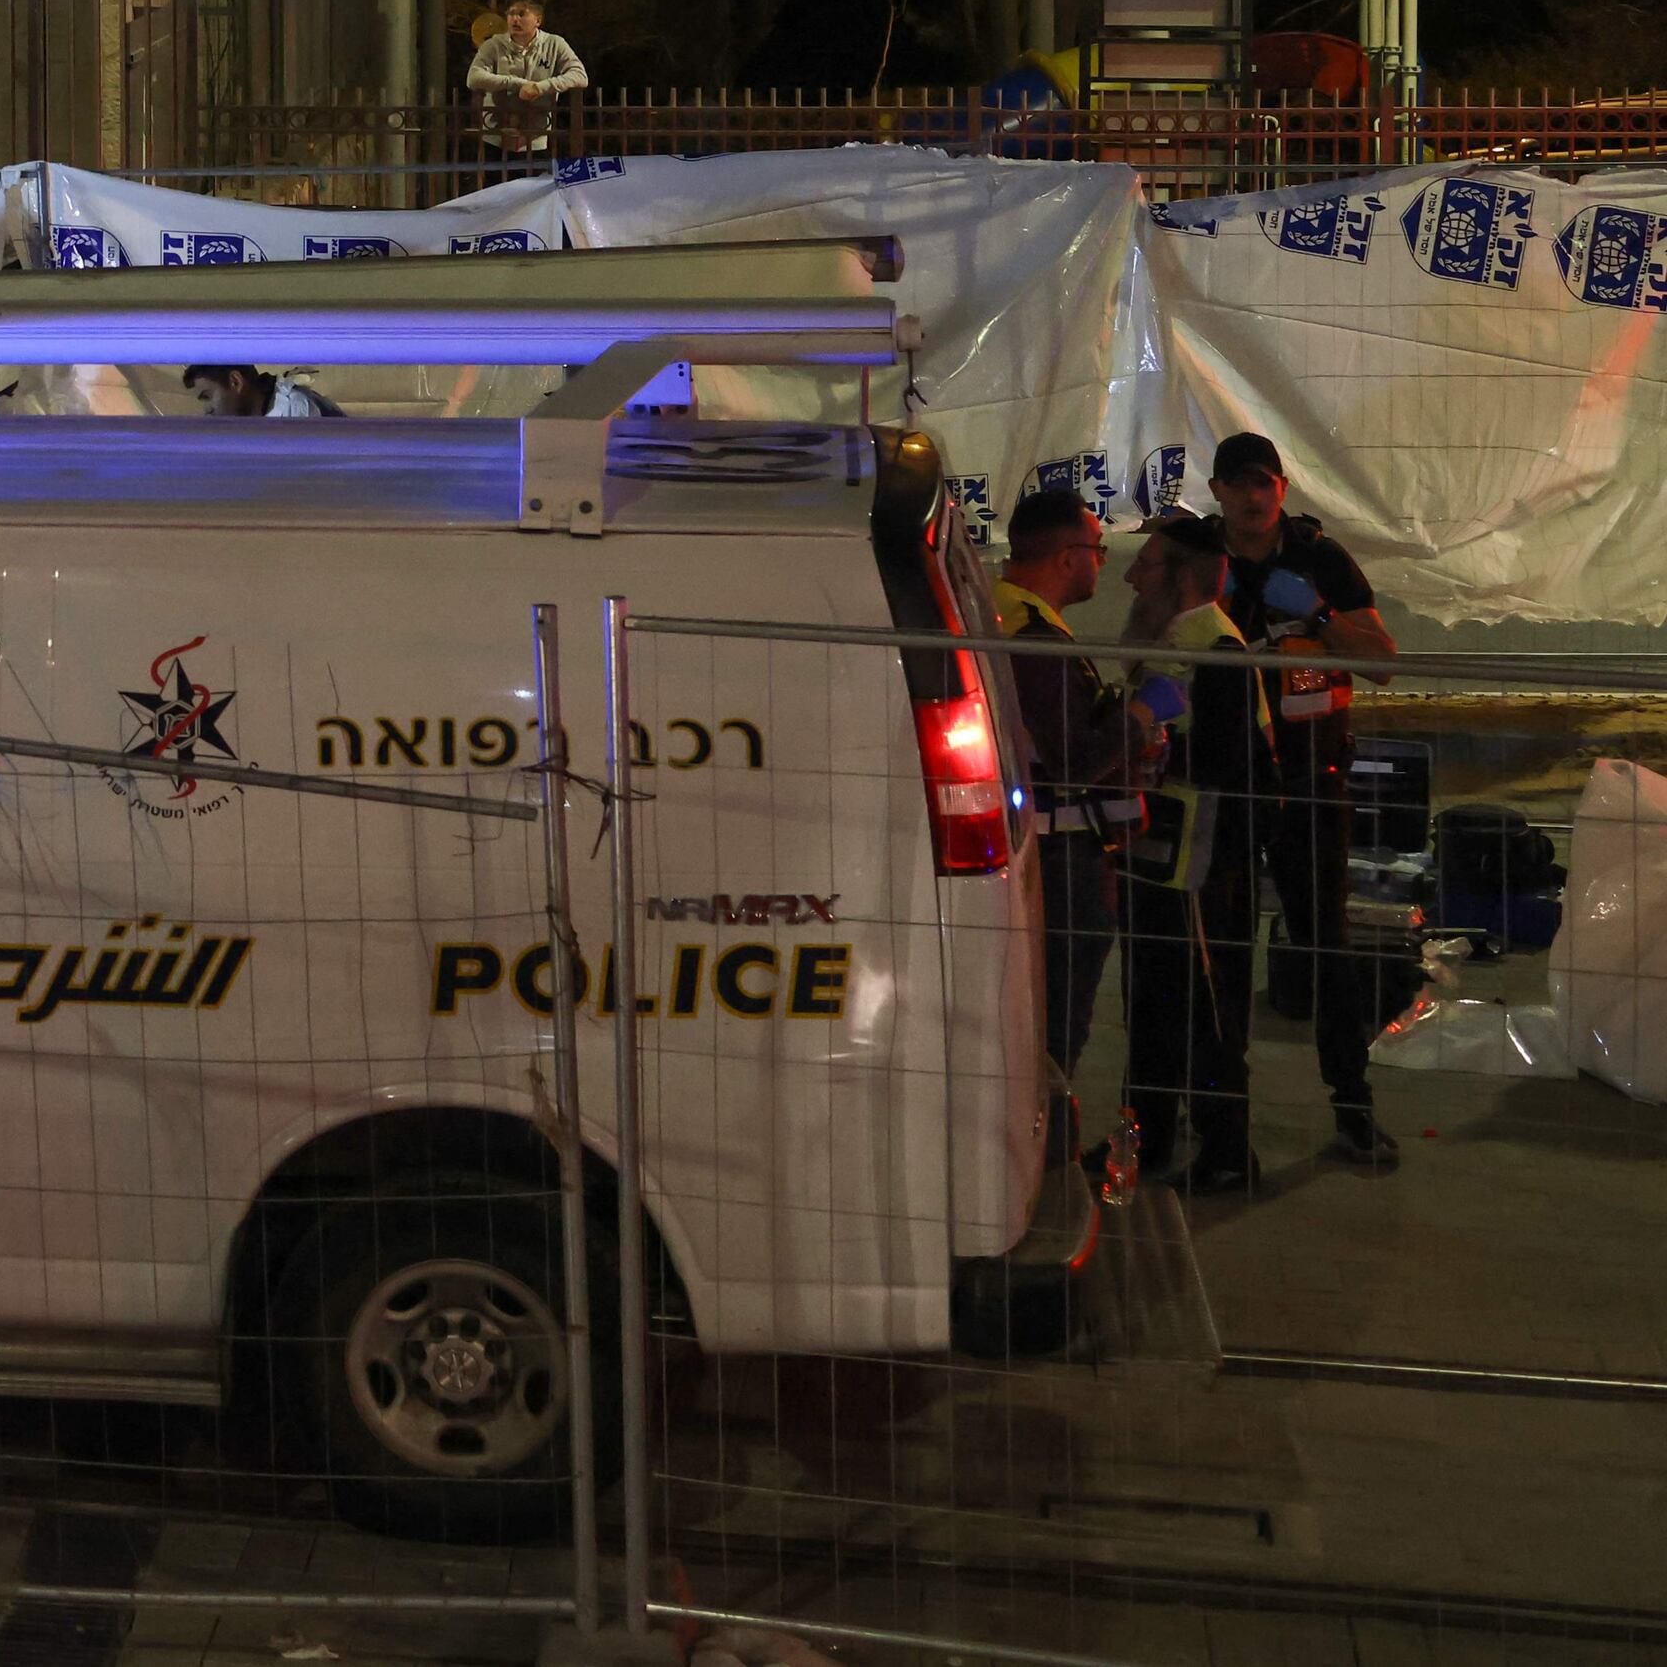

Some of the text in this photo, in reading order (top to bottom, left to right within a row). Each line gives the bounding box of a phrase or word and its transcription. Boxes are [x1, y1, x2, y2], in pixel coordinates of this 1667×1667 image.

[1332, 226, 1344, 257] איתור
[1420, 194, 1439, 255] חסד של אמת
[1482, 188, 1506, 283] איתור חילוץ הצלה
[1494, 191, 1538, 289] זק"א
[1634, 278, 1645, 309] איתור
[1646, 215, 1657, 243] הצלה
[316, 717, 569, 769] פואה
[96, 764, 230, 820] רפואי משטרת ישרא
[432, 941, 852, 1020] POLICE
